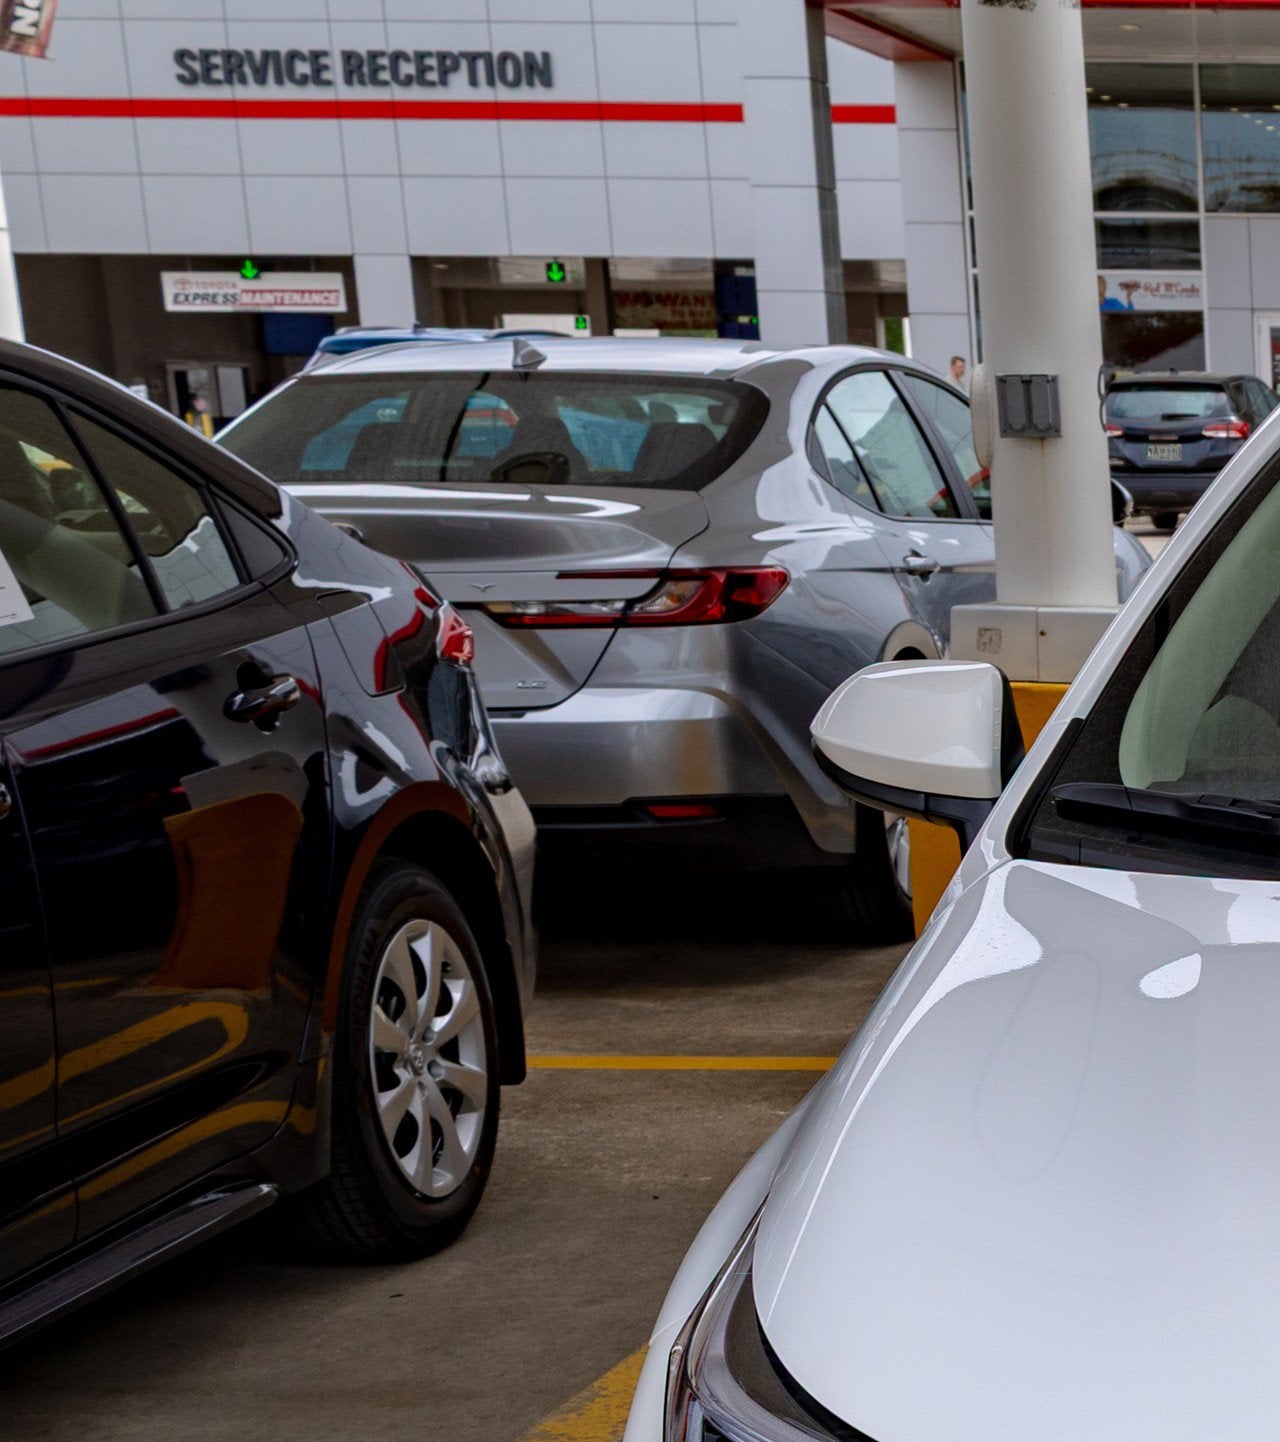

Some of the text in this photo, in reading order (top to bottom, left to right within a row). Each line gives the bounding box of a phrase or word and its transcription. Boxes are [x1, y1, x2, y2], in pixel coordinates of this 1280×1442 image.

[173, 49, 554, 88] SERVICE RECEPTION
[195, 281, 237, 289] TOYOTA
[173, 291, 339, 305] EXPRESS MAINTENANCE
